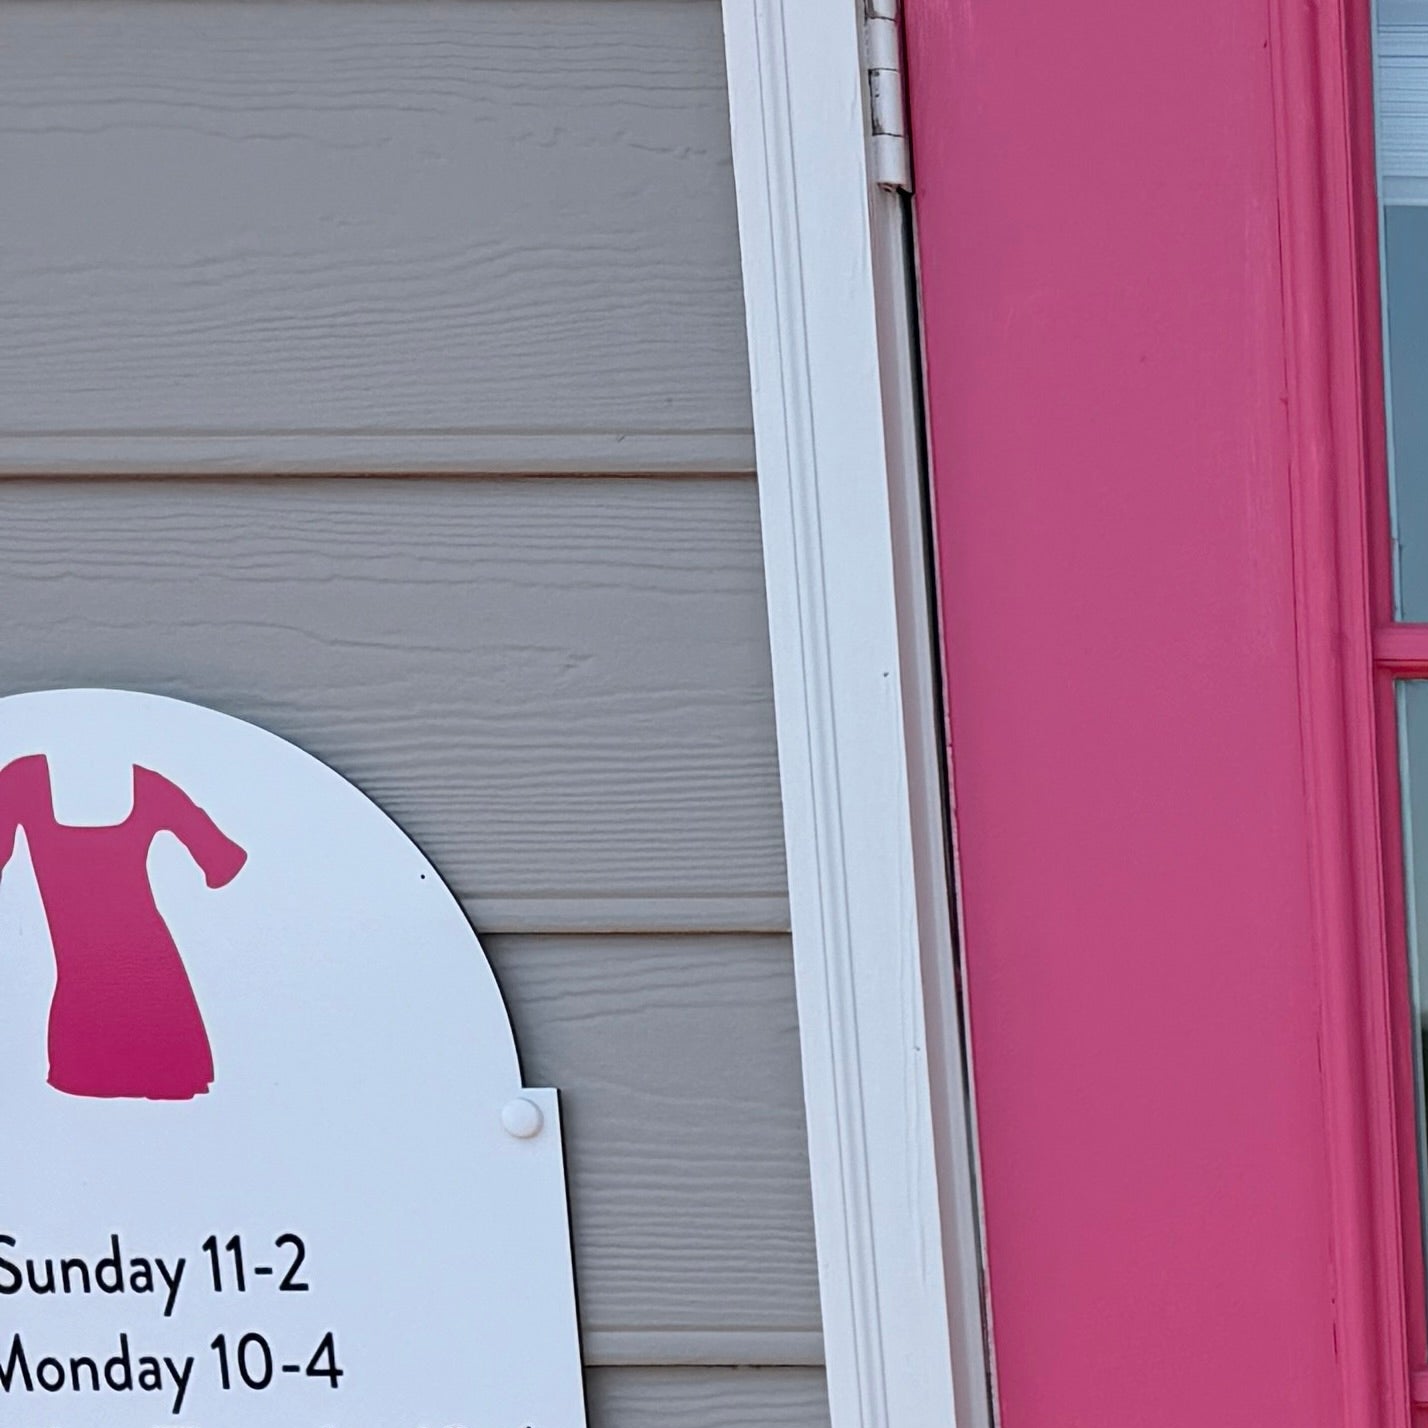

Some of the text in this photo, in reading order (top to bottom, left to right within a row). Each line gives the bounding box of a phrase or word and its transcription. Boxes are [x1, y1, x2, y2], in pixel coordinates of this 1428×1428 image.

[0, 1233, 309, 1317] Sunday 11-2
[0, 1331, 344, 1415] Monday 10-4
